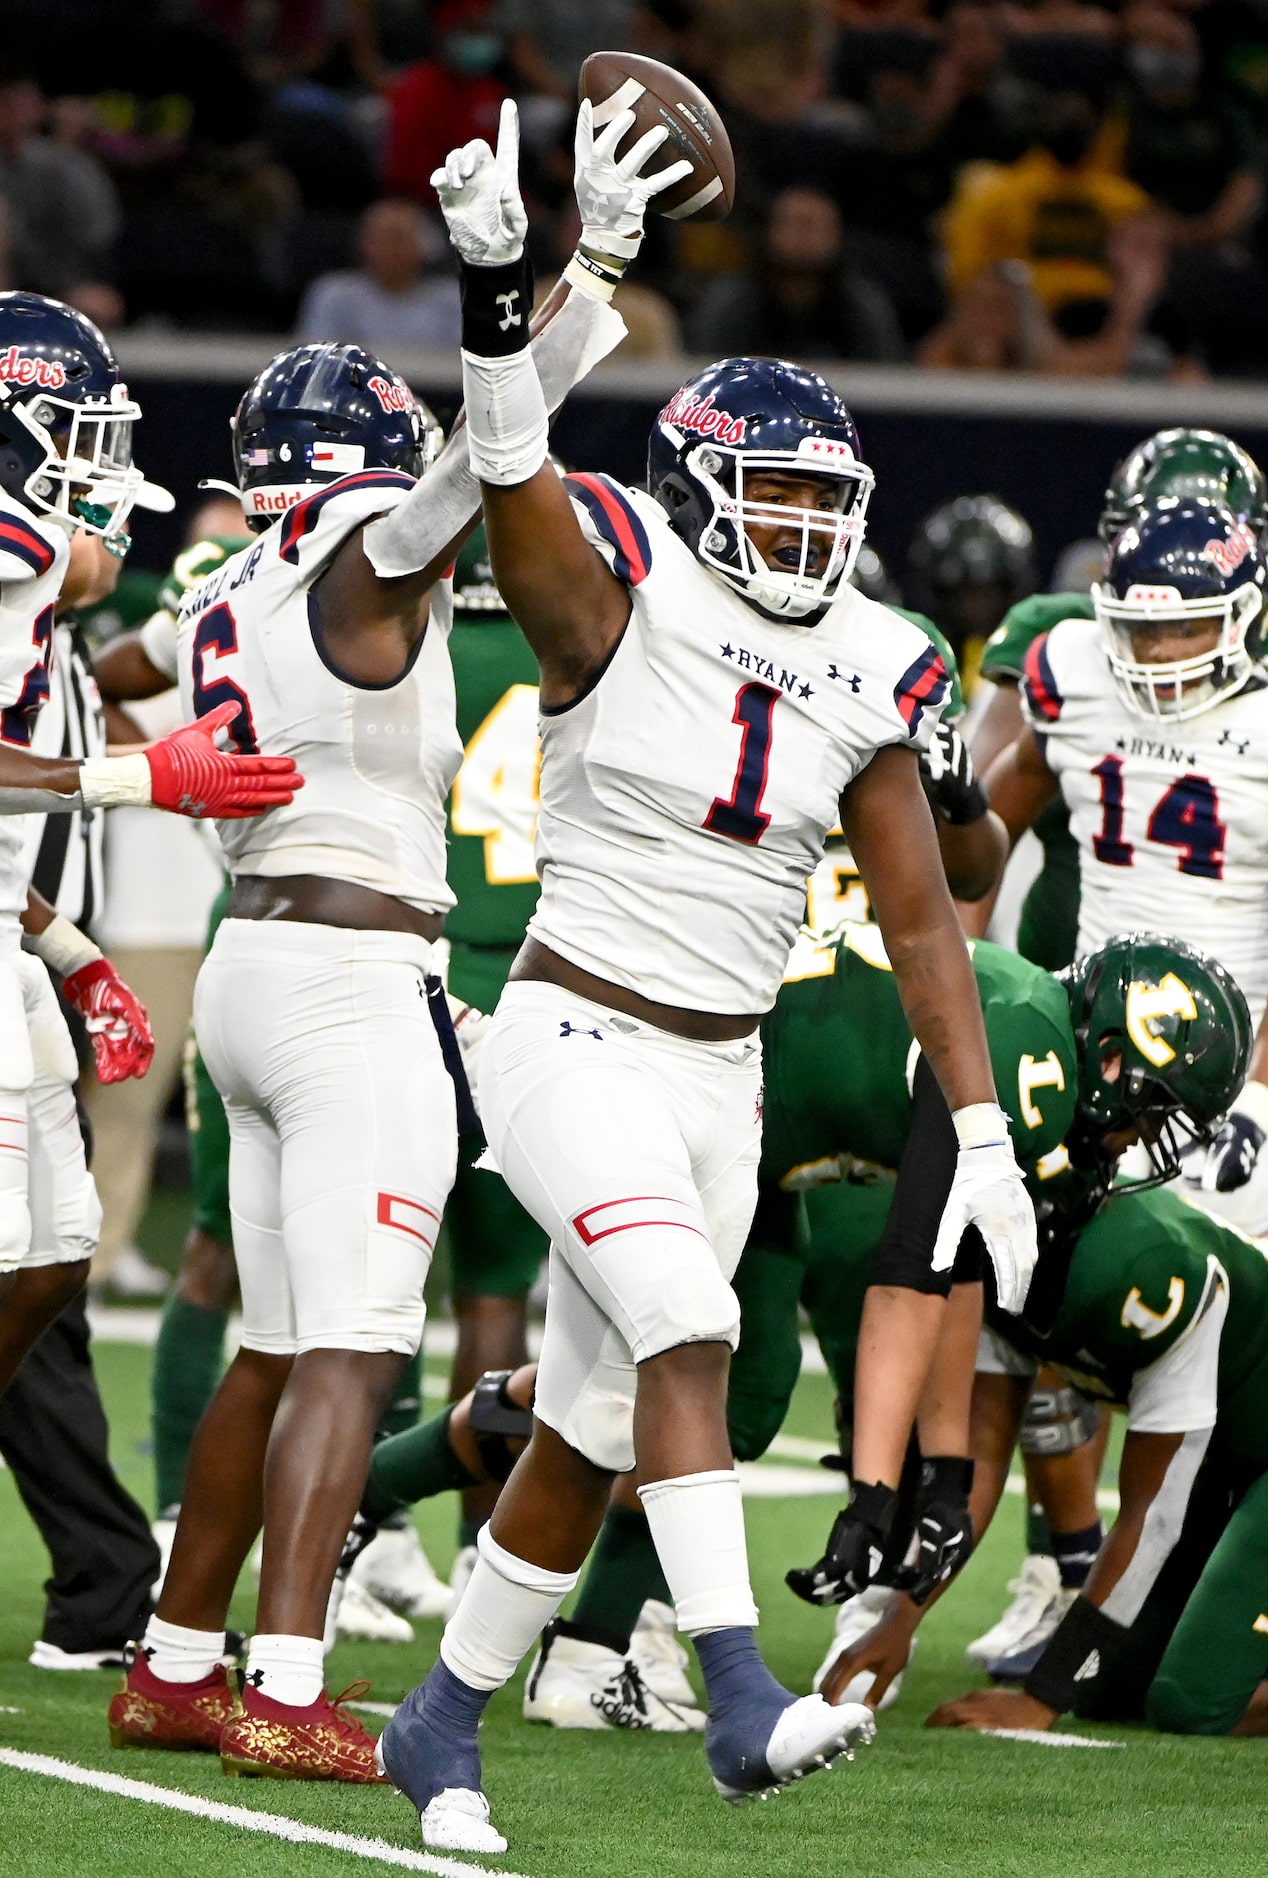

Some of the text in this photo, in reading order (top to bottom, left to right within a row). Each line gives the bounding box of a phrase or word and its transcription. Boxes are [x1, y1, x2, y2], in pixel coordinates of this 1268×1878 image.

[279, 443, 292, 462] 6
[192, 601, 261, 755] 6
[737, 648, 798, 693] RYAN
[451, 683, 541, 885] 4
[701, 681, 783, 845] 1
[1130, 737, 1183, 764] RYAN
[1089, 753, 1227, 880] 14
[1126, 972, 1198, 1068] L
[1018, 1050, 1065, 1130] L
[1121, 1276, 1185, 1340] L
